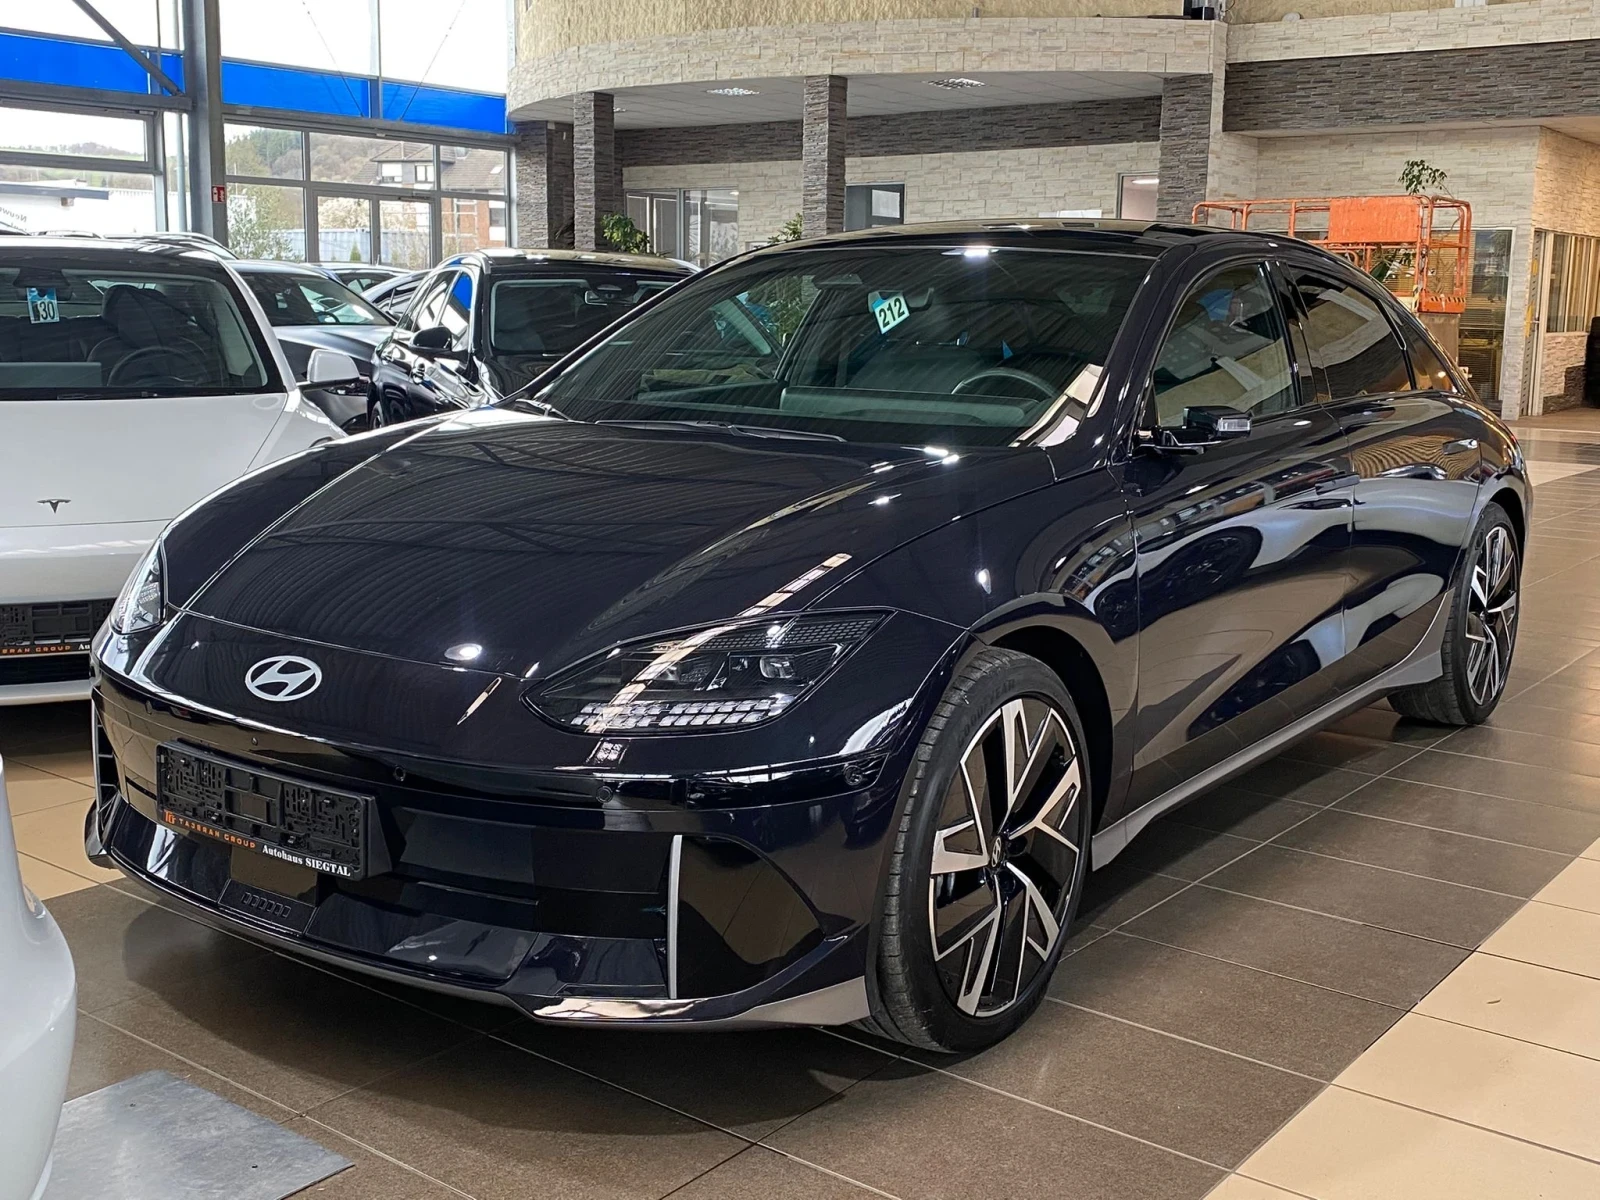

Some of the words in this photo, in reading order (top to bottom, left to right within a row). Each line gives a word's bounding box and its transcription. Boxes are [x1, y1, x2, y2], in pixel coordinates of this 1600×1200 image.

[878, 297, 906, 329] 212
[35, 645, 71, 653] GROUP
[223, 833, 256, 849] GROUP
[262, 845, 303, 866] Autohaus
[305, 857, 351, 877] SIEGTAL
